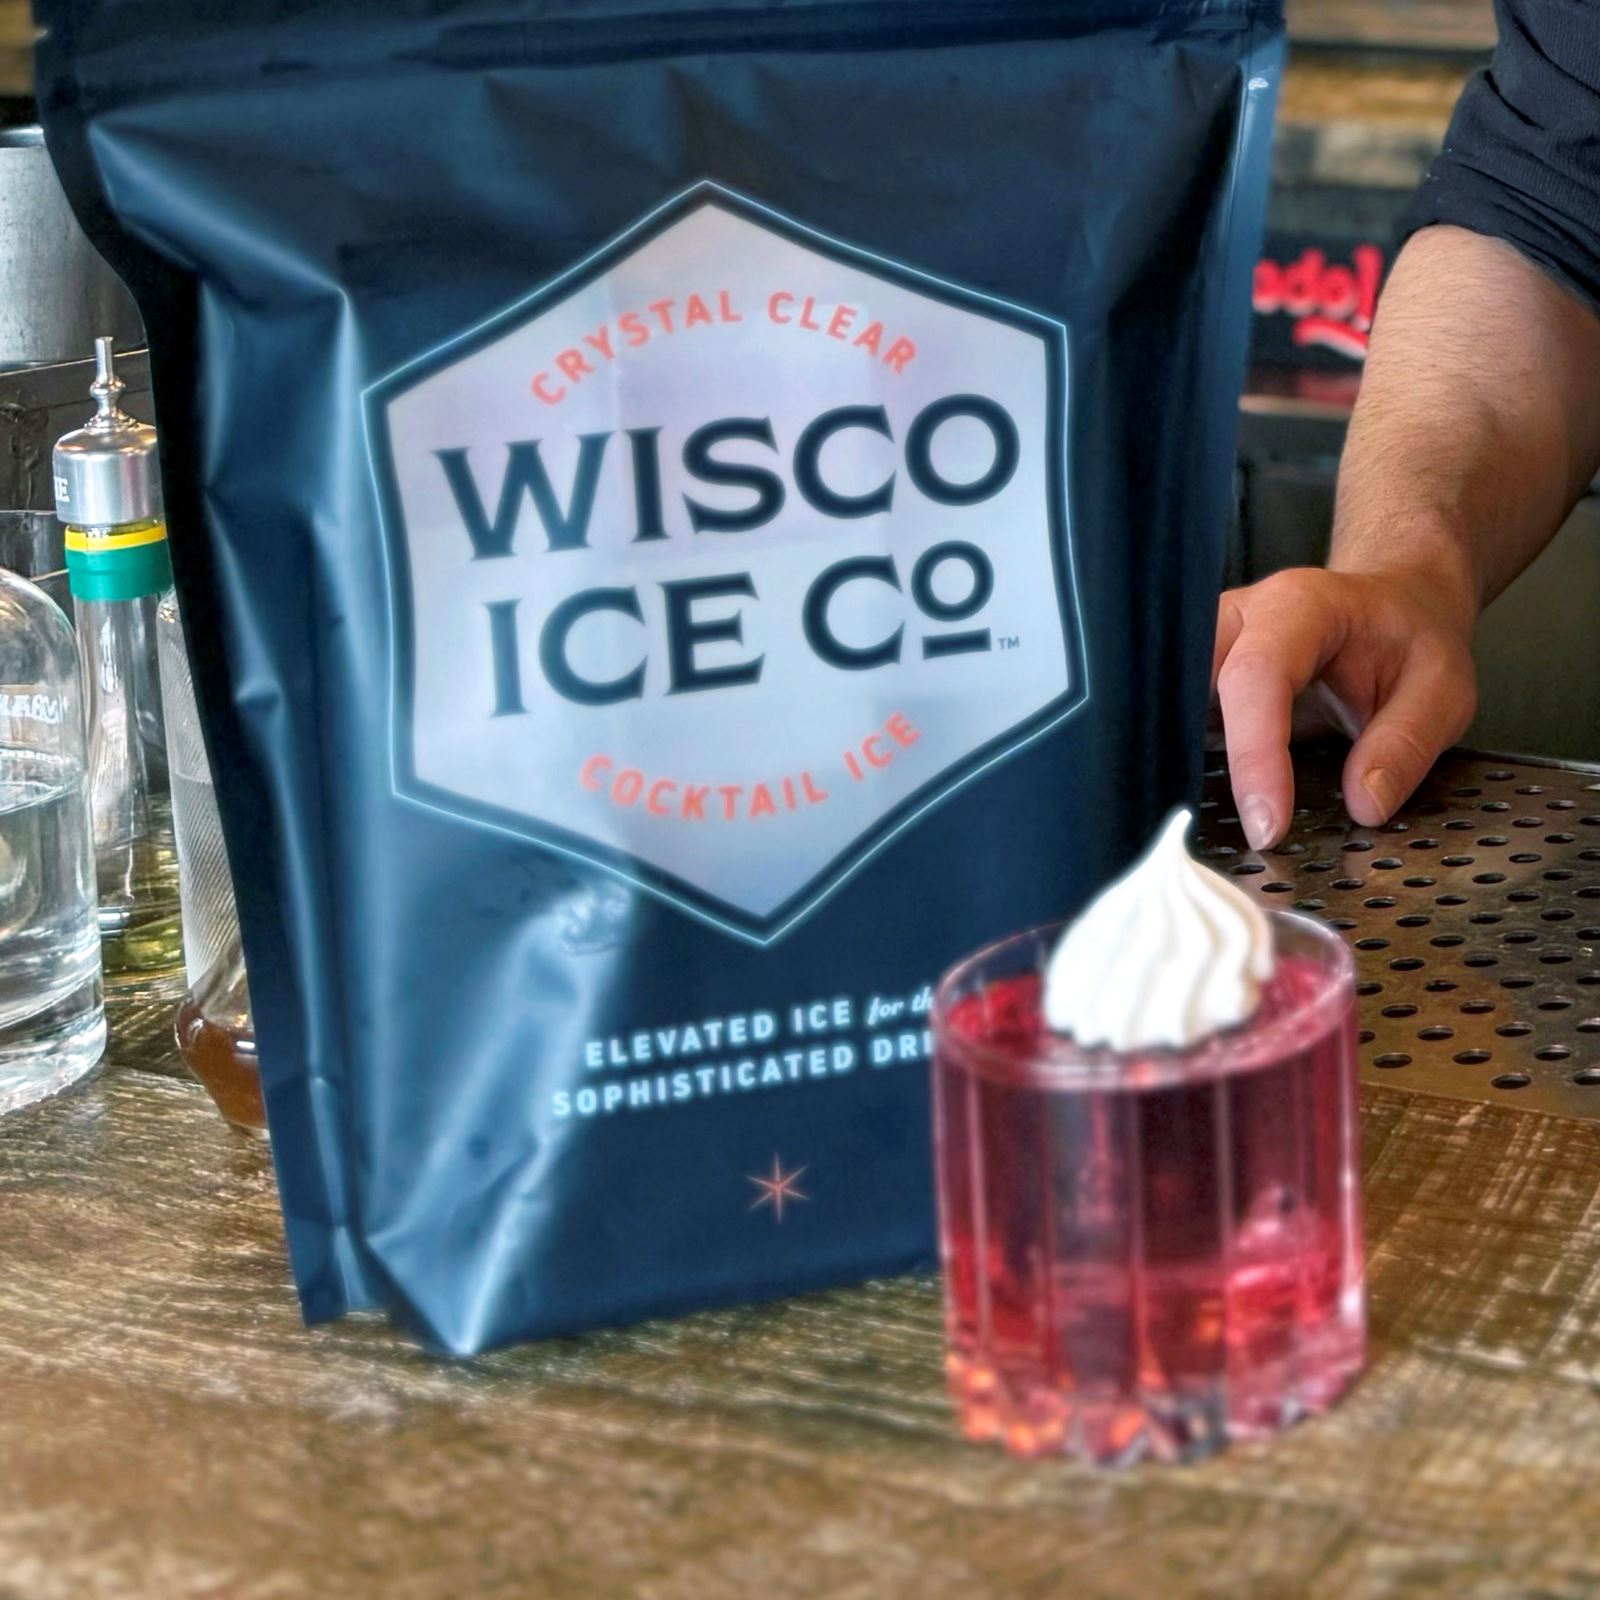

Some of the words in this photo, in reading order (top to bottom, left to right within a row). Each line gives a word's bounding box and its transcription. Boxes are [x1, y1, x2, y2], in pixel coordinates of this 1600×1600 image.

[530, 290, 743, 406] CRYSTAL
[767, 290, 918, 375] CLEAR
[432, 393, 1021, 562] WISCO
[484, 571, 767, 719] ICE
[579, 753, 829, 822] COCKTAIL
[843, 711, 923, 782] ICE
[552, 1045, 855, 1117] SOPHISTICATED
[872, 1030, 934, 1063] DRI
[585, 1013, 775, 1068] ELEVATED
[794, 1000, 851, 1032] ICE
[867, 997, 905, 1026] for
[911, 986, 934, 1012] th
